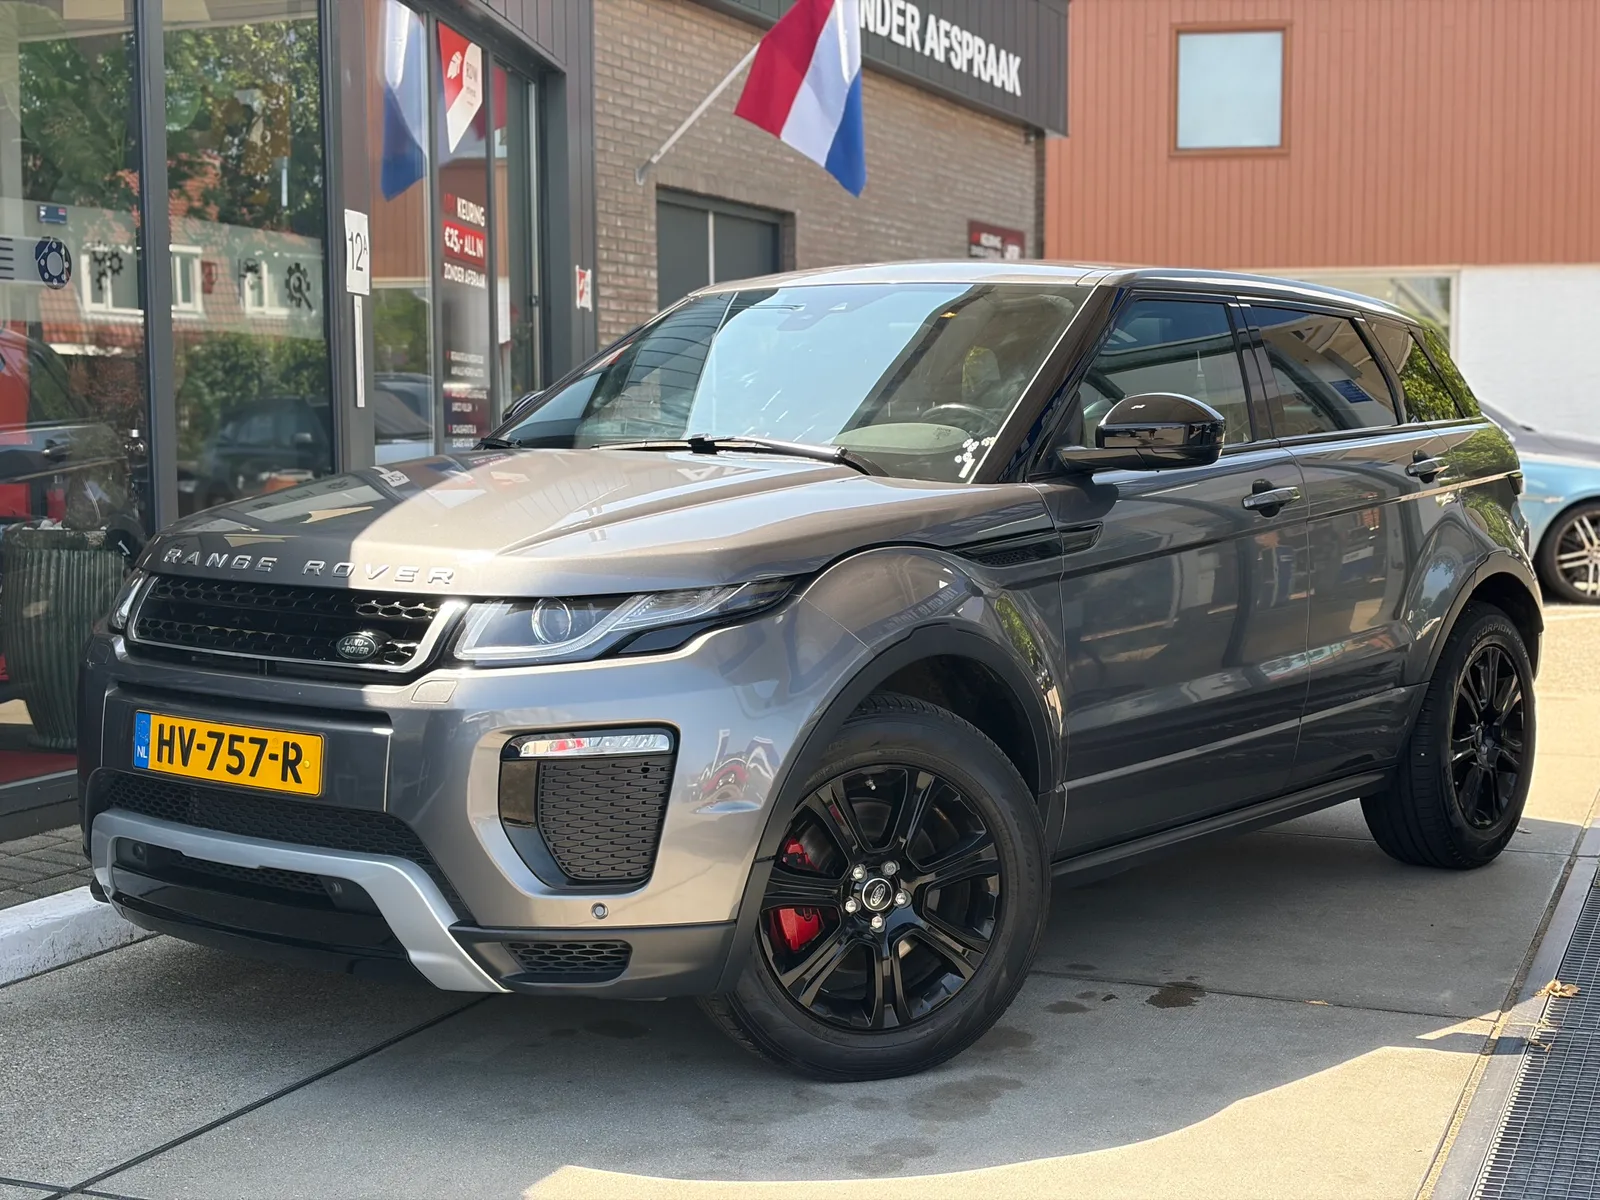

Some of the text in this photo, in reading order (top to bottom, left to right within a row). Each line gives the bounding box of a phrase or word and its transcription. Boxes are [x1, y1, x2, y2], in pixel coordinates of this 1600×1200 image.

[923, 14, 1022, 97] AFSPRAAK
[456, 196, 485, 227] KEURING
[162, 548, 456, 585] RANGE ROVER
[344, 638, 365, 647] LAND
[344, 646, 369, 654] ROVER
[136, 745, 148, 759] NL
[156, 723, 303, 785] HV-757-R
